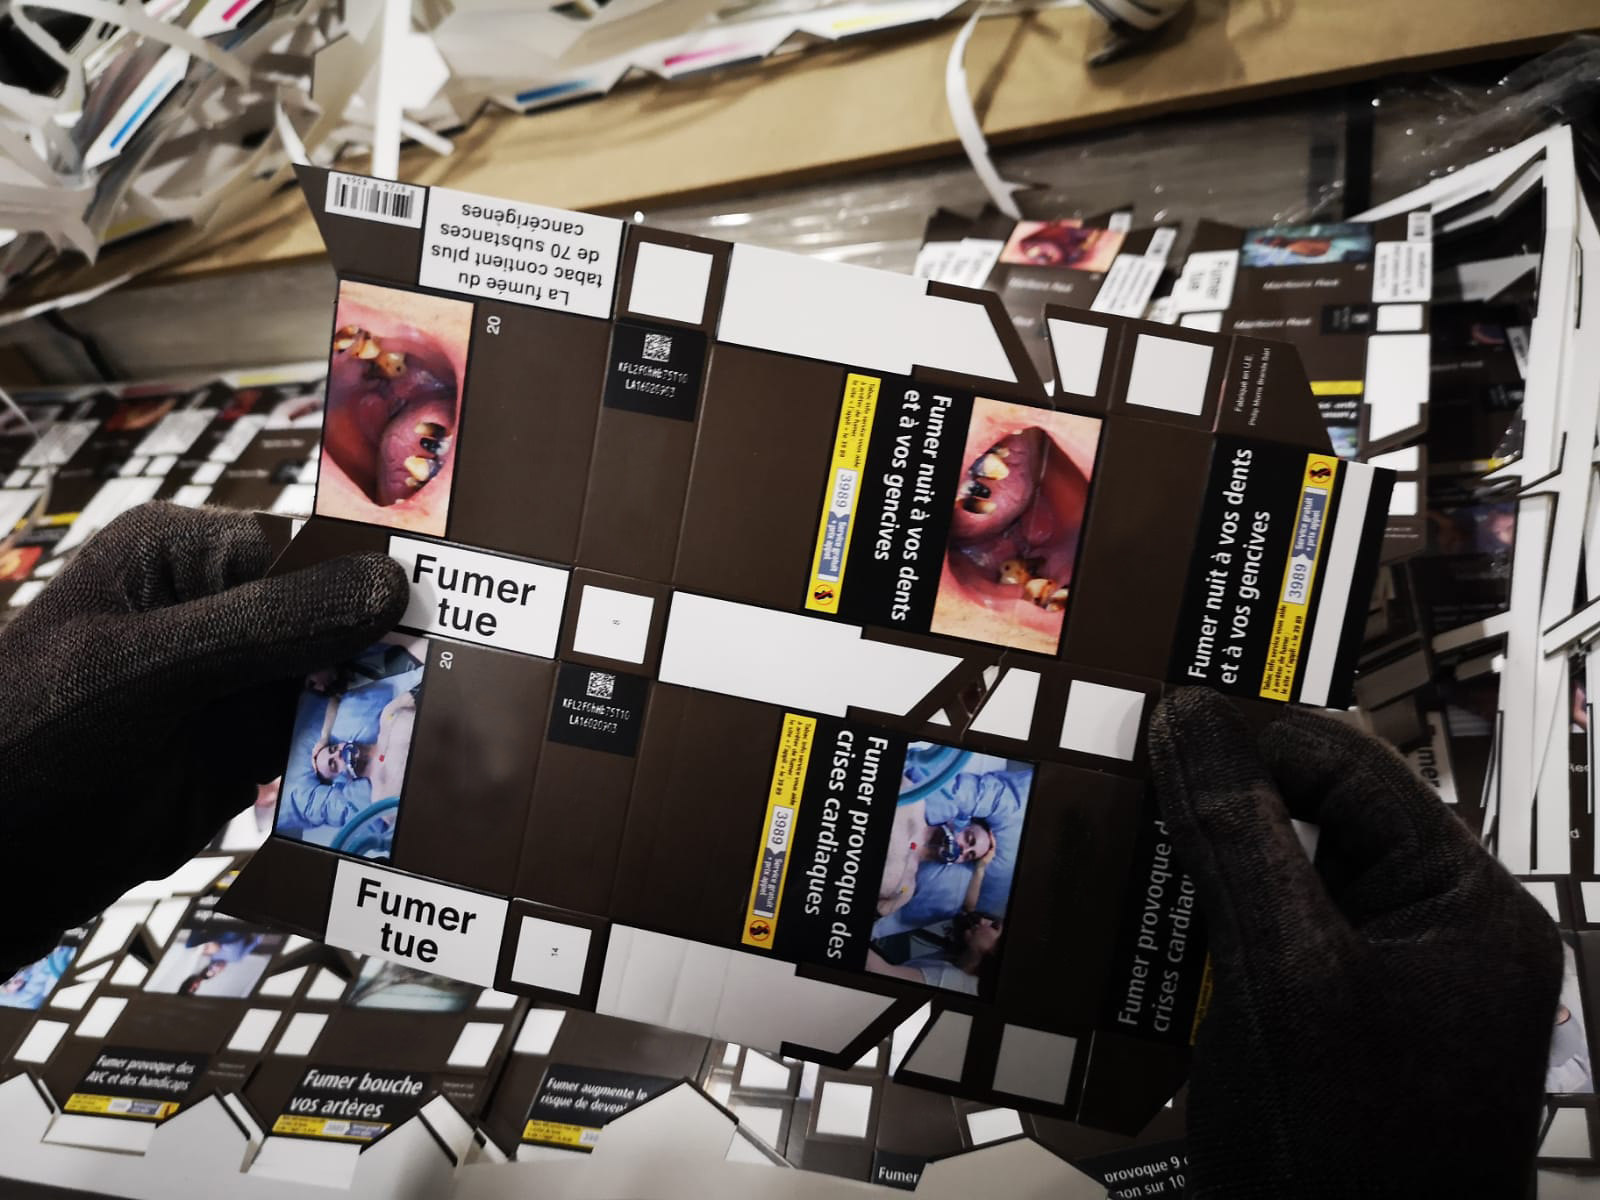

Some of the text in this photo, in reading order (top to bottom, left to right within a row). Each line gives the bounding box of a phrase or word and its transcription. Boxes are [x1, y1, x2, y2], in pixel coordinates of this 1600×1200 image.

[461, 203, 584, 236] cancérigènes
[440, 223, 600, 265] de 70 substances
[431, 243, 602, 288] tabac contient plus
[458, 272, 569, 305] La fumée du
[486, 316, 501, 335] 20
[834, 474, 852, 508] 3989
[874, 389, 921, 561] et à vos gencives
[891, 394, 953, 622] Fumer nuit à vos dents
[412, 553, 536, 606] Fumer
[1188, 448, 1253, 678] Fumer nuit à vos dents
[1288, 563, 1307, 598] 3989
[1221, 511, 1271, 684] et à vos gencives
[438, 597, 497, 637] tue
[440, 651, 454, 670] 20
[1417, 742, 1441, 788] mer
[770, 811, 789, 845] 3989
[804, 730, 857, 916] crises cardiaques
[827, 736, 889, 959] Fumer provoque des
[356, 877, 477, 935] Fumer
[380, 922, 439, 963] tue
[1117, 954, 1150, 1025] Fumer
[1137, 843, 1173, 951] provoque
[1152, 874, 1196, 1032] crises cardiaq
[85, 1070, 190, 1092] AVC et des handicaps
[96, 1054, 127, 1068] Fumer
[125, 1058, 175, 1074] provoque
[176, 1061, 195, 1074] des
[302, 1068, 358, 1089] Fumer
[358, 1072, 423, 1095] bouche
[540, 1094, 573, 1109] risque
[575, 1095, 589, 1109] de
[546, 1077, 648, 1100] Fumer augmente le
[290, 1096, 384, 1118] vos artères
[878, 1166, 919, 1184] Fumer
[1170, 1155, 1180, 1169] 9
[1144, 1180, 1164, 1195] sur
[1169, 1174, 1185, 1189] 10
